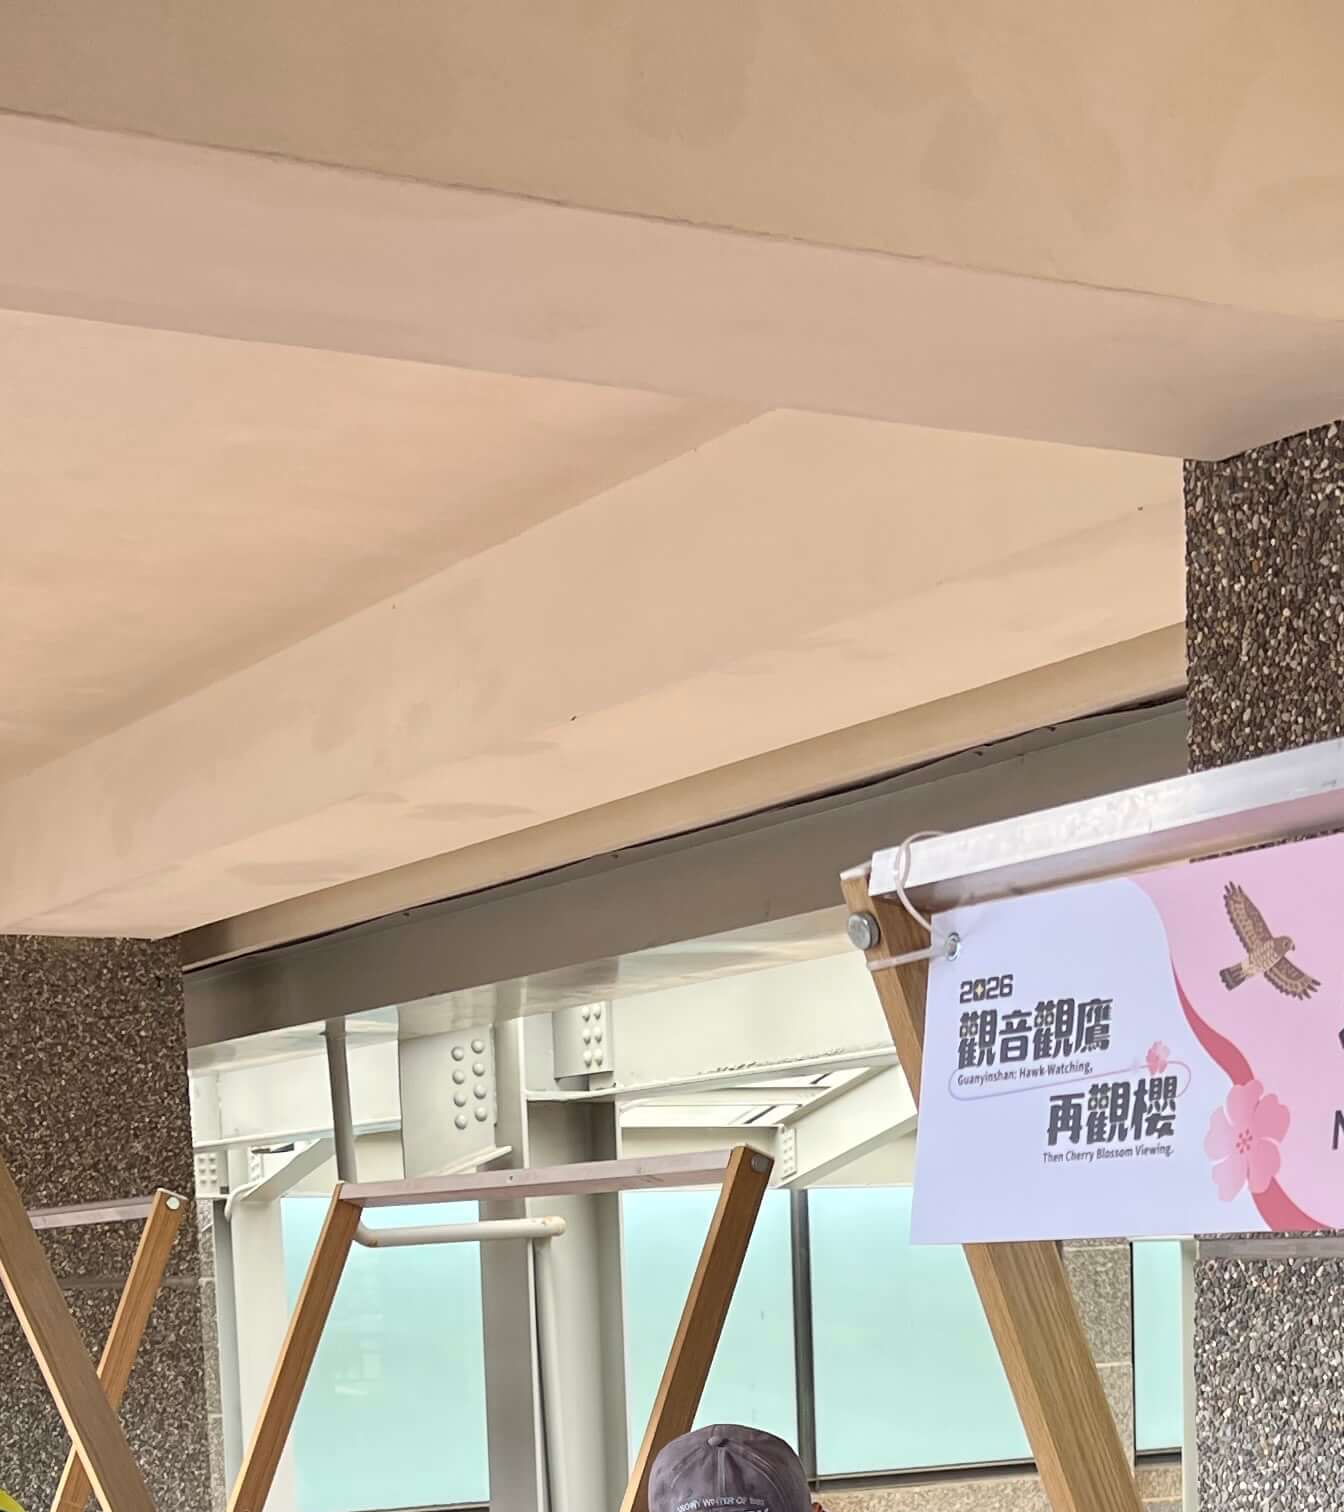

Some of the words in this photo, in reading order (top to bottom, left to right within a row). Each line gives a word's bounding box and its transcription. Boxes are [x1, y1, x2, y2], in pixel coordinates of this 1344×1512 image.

[959, 974, 1014, 1004] 2026
[958, 998, 1113, 1069] 觀音觀鷹
[1047, 1076, 1178, 1146] 再觀櫻
[1043, 1152, 1064, 1164] Then
[1065, 1149, 1094, 1163] Cherry
[1096, 1146, 1133, 1160] Blossom
